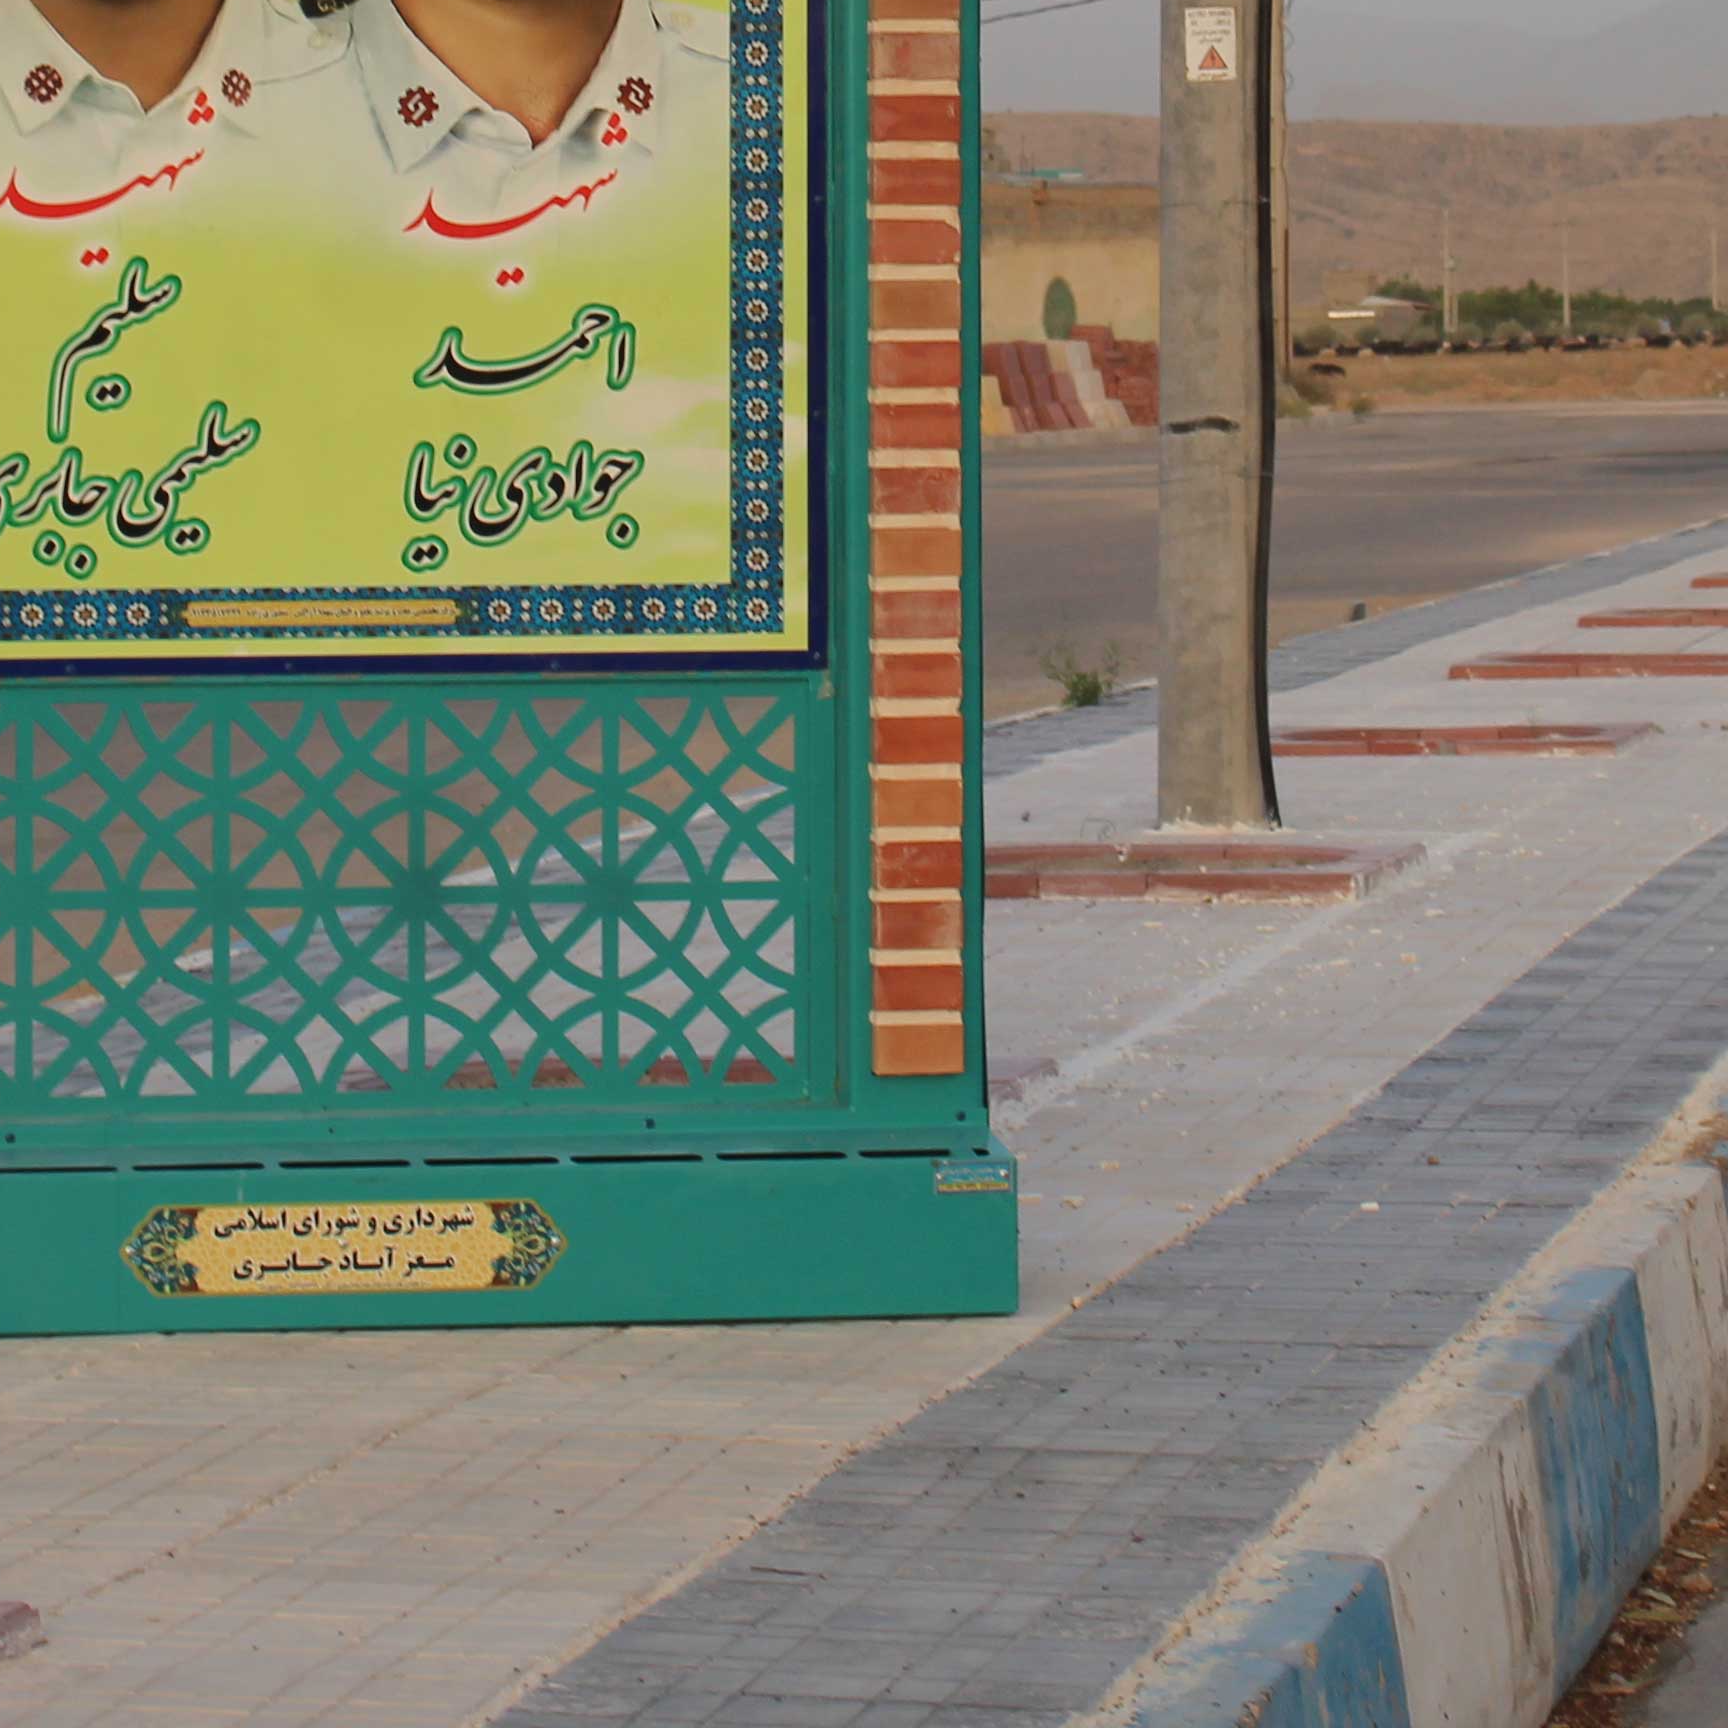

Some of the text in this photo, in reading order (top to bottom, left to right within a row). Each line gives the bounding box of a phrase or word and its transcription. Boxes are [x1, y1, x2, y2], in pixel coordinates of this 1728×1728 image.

[401, 111, 630, 288] شهید
[50, 258, 180, 441] سلیم
[415, 304, 635, 394] احمد
[107, 401, 259, 554] سلیمی
[460, 440, 643, 548] جوادی
[213, 1204, 475, 1239] شهرداری و شورای اسلامی
[232, 1249, 333, 1281] جابری
